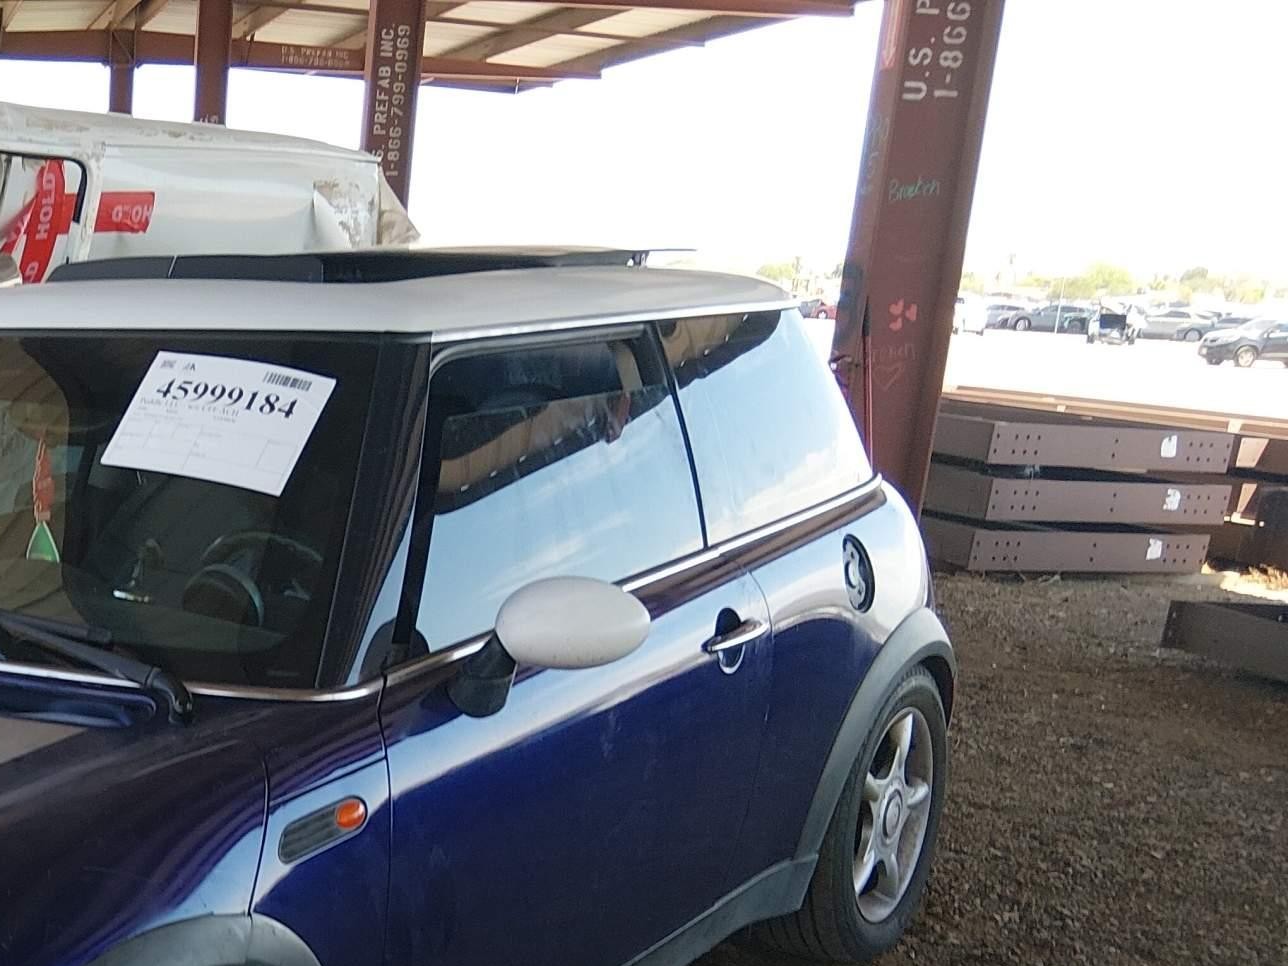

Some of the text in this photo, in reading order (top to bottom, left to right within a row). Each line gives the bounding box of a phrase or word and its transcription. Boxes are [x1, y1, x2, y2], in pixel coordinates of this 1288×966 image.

[380, 23, 395, 57] INC.
[934, 2, 971, 98] 1-866
[373, 66, 392, 135] PREFAB
[385, 25, 411, 177] 1-866-799-0969
[35, 172, 56, 241] HOLD
[156, 377, 298, 419] 45999184
